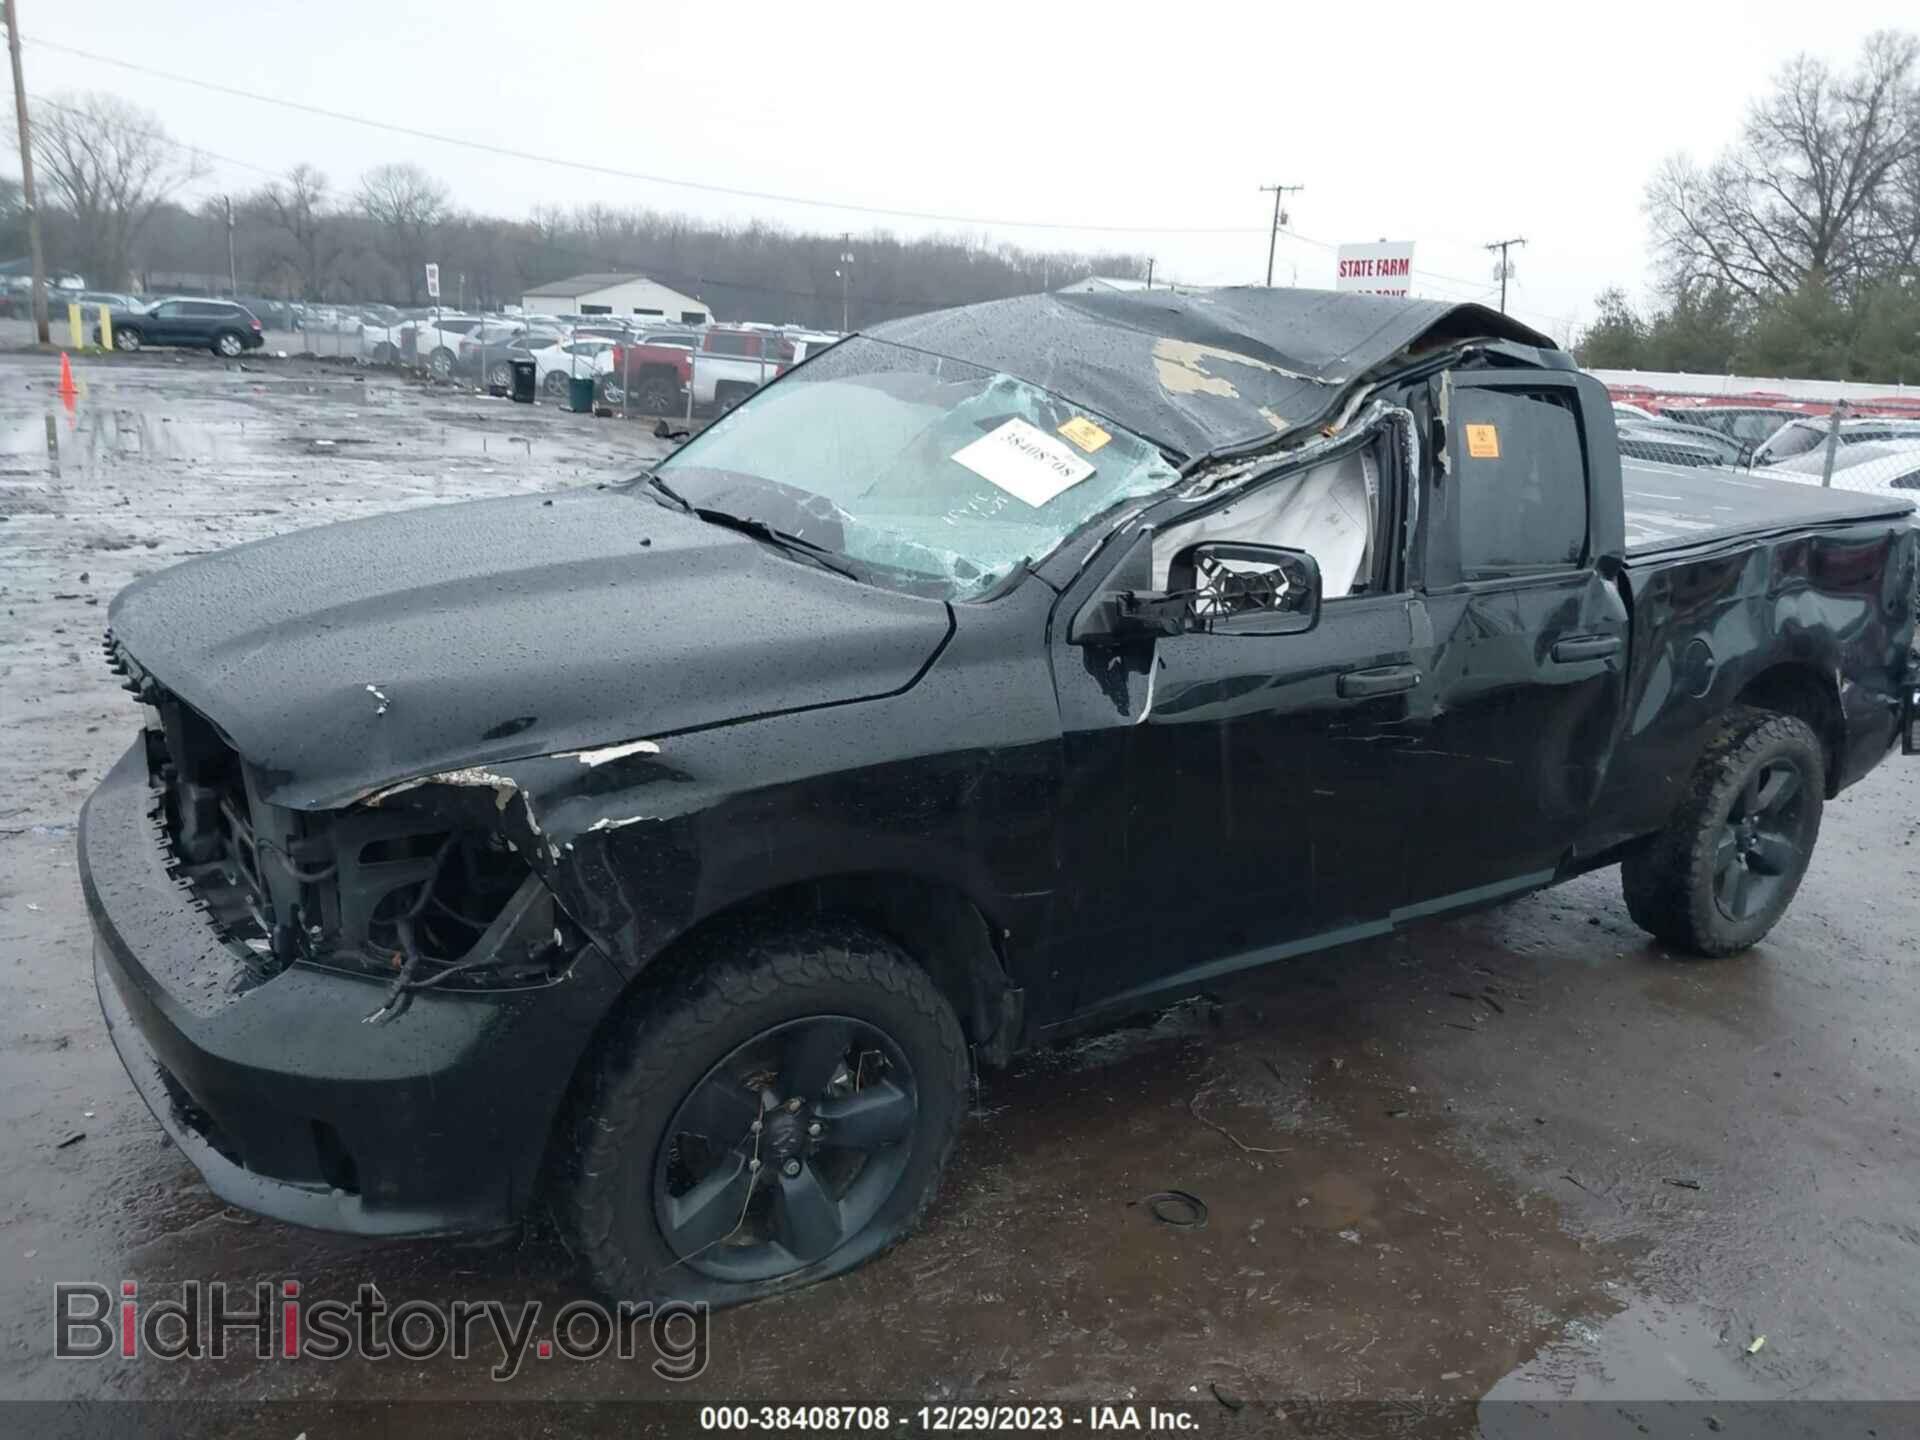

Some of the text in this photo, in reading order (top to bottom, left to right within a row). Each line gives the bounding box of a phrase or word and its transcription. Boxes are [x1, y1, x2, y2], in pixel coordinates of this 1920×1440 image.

[1339, 257, 1410, 278] STATE FARM
[999, 431, 1076, 478] 38408708
